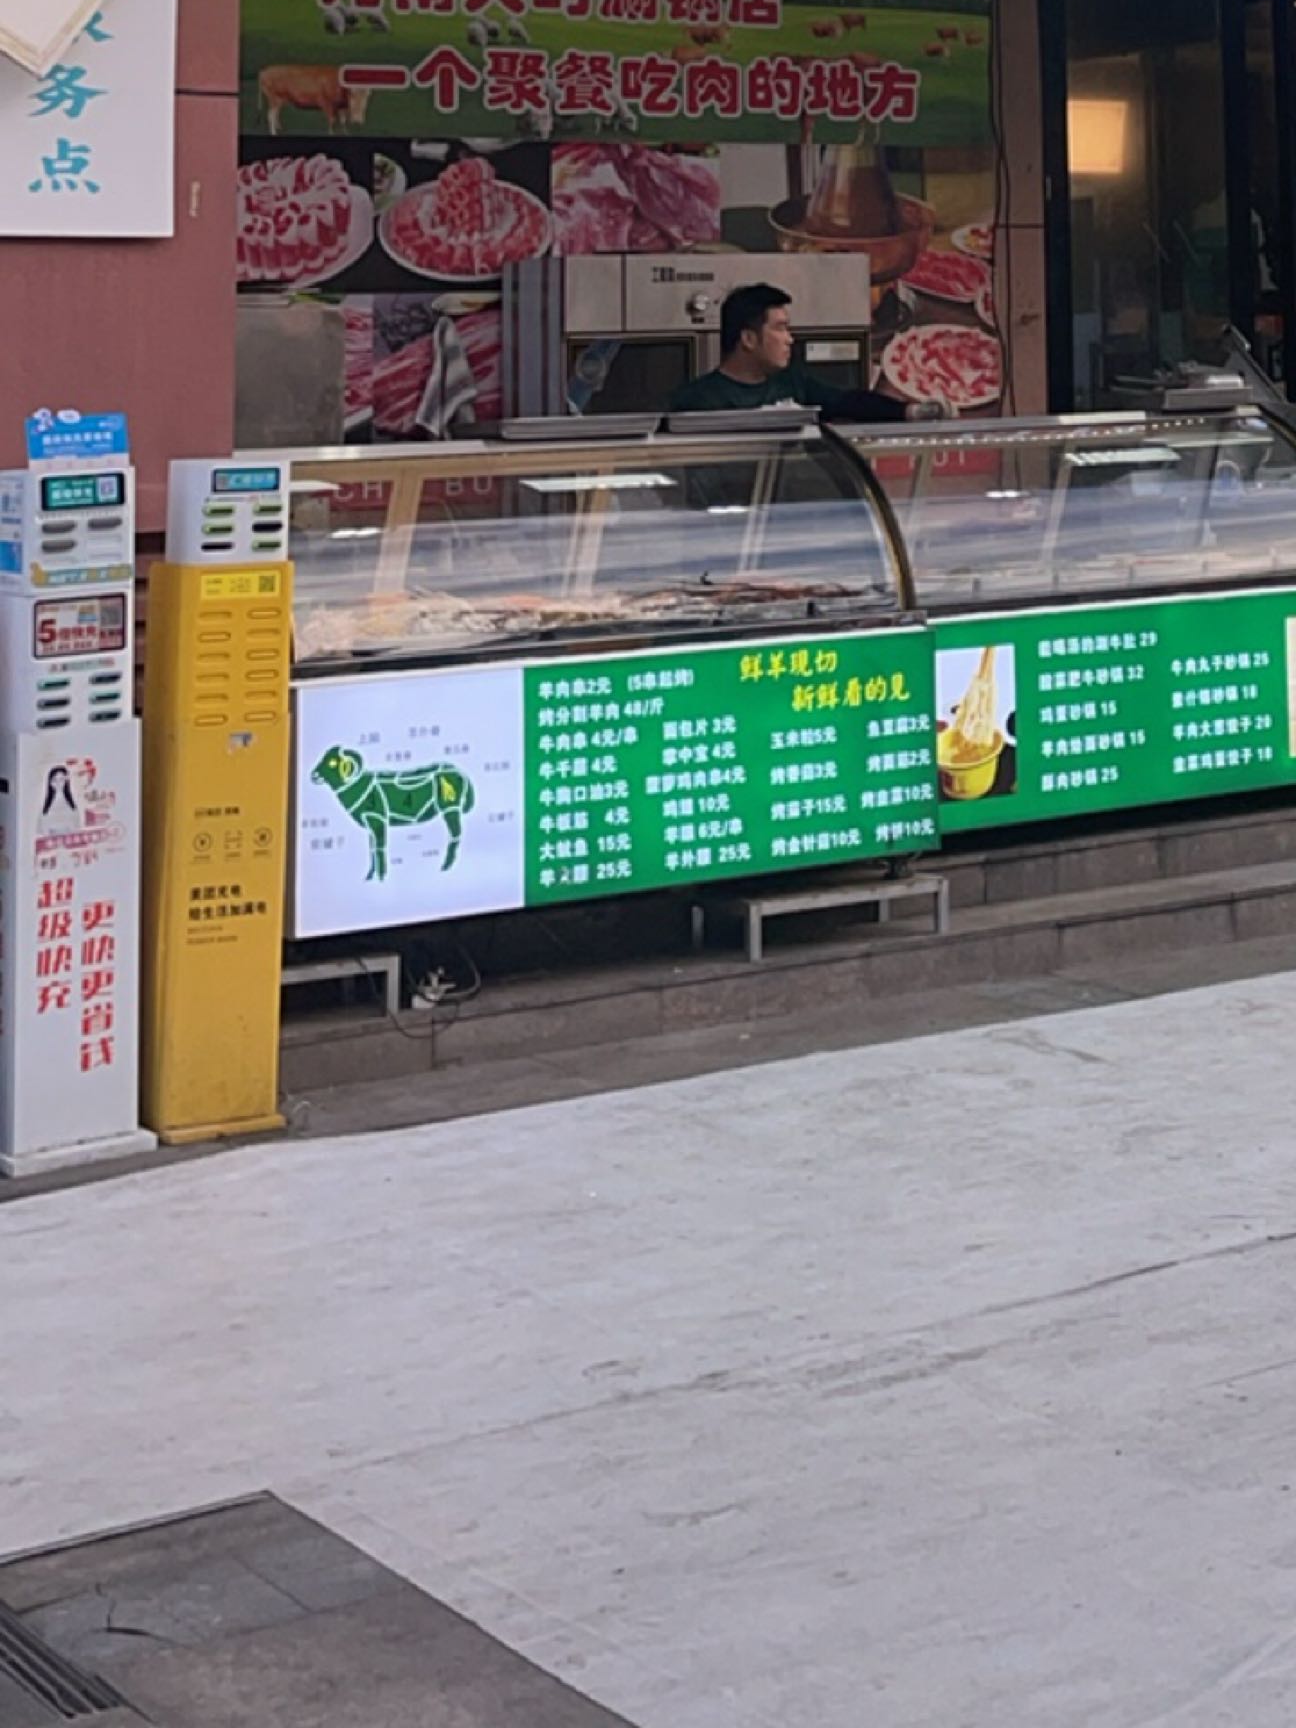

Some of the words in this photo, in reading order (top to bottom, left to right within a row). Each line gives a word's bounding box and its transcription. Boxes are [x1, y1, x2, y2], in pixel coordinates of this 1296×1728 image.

[28, 11, 113, 193] 务点
[341, 49, 917, 121] 一个聚餐吃肉的地方
[740, 649, 837, 682] 鲜羊现切
[792, 674, 910, 713] 新鲜看的见
[538, 729, 586, 754] 牛肉串
[37, 878, 74, 1014] 超级快充
